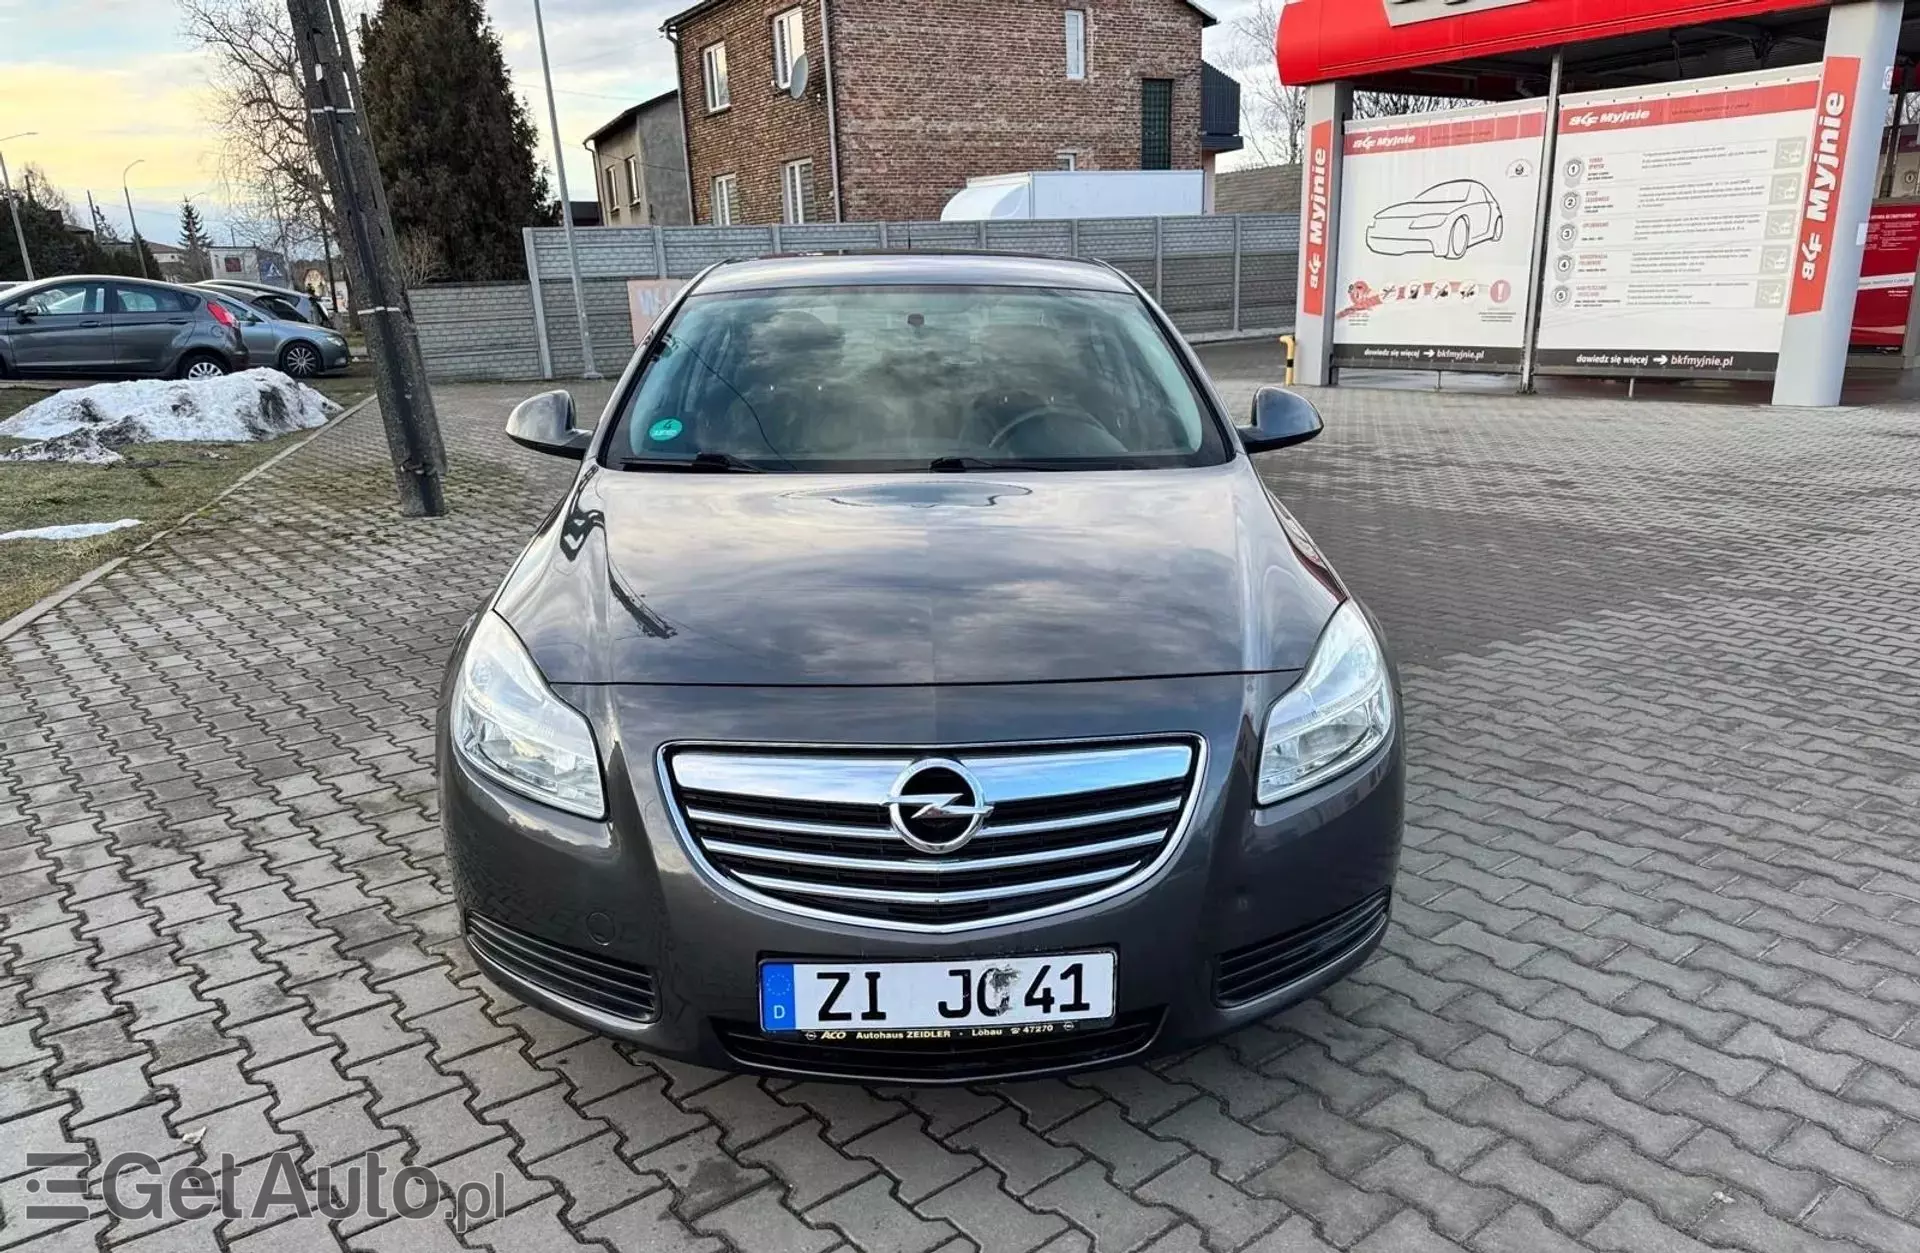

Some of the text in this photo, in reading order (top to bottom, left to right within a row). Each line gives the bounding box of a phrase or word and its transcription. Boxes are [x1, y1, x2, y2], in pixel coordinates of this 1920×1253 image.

[1600, 109, 1651, 126] Myjnie
[1377, 134, 1416, 147] Myjnie
[1806, 92, 1846, 221] Myjnie
[1310, 147, 1327, 246] Myjnie
[1364, 348, 1420, 358] dowiedz się więcej
[1436, 350, 1485, 361] bkfmyjnie.pl
[1576, 353, 1649, 366] dowiedz się więcej
[1671, 355, 1734, 368] bkfmyjnie.pl
[817, 971, 887, 1021] ZI
[773, 1005, 786, 1019] D
[821, 1030, 847, 1039] ACO
[856, 1031, 904, 1040] Autohaus
[906, 1030, 951, 1039] ZEIDLER
[1023, 1024, 1054, 1034] 47270
